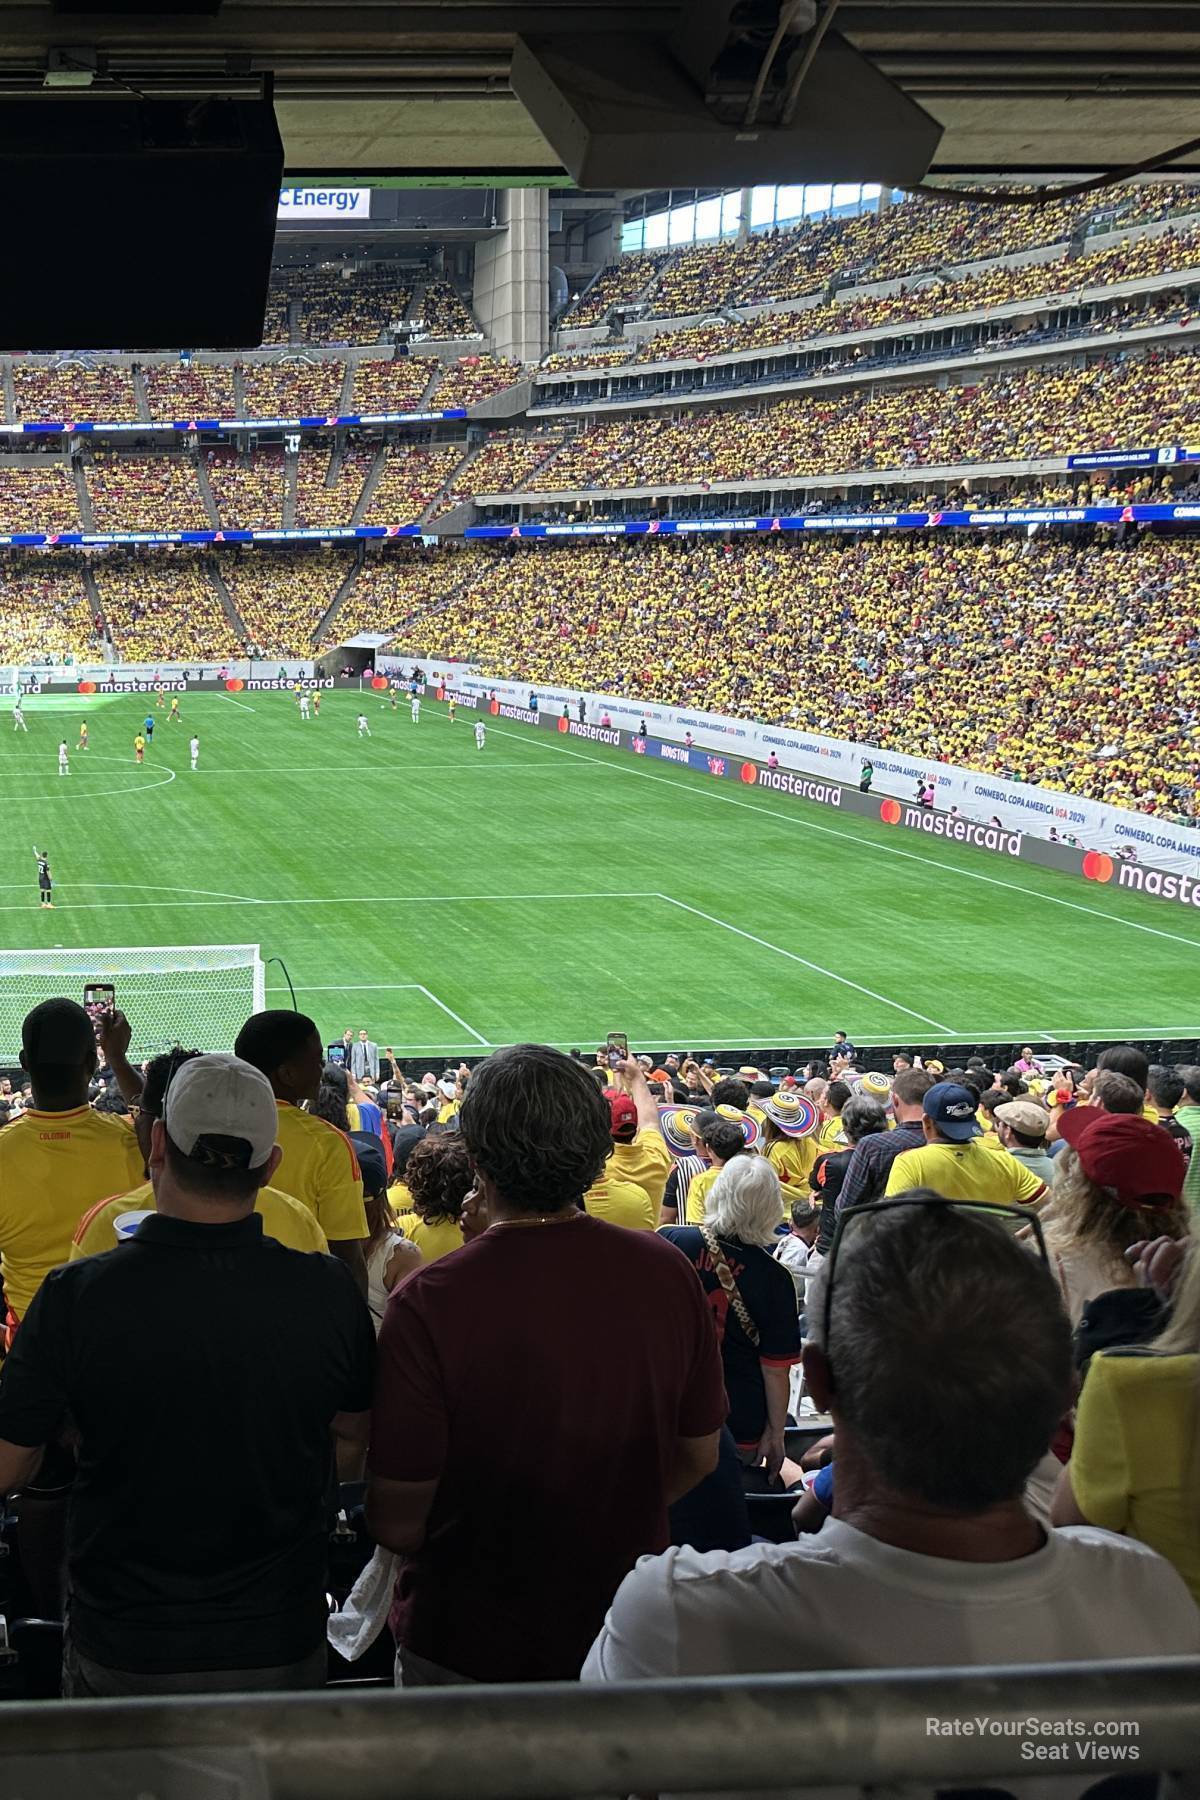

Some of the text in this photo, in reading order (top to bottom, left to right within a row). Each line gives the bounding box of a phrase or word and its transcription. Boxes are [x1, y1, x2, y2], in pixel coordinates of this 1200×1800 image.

[293, 188, 360, 210] Energy
[1164, 448, 1172, 460] 2
[100, 680, 187, 693] mastercard
[247, 676, 334, 690] mastecard
[499, 705, 539, 725] mastercard
[569, 721, 621, 746] mastercard
[661, 745, 689, 764] HOUSTON
[762, 735, 786, 747] CONMEBOL
[786, 739, 800, 749] COPA
[799, 742, 820, 754] AMERICA
[820, 748, 829, 756] USA
[888, 764, 902, 774] COPA
[902, 767, 927, 780] AMERICA
[927, 773, 938, 783] USA
[938, 776, 952, 787] 2024
[759, 769, 842, 807] mastercard
[974, 785, 1086, 824] CONMEBOL COPA AMERICA USA 2024
[904, 808, 1022, 857] mastercard
[1114, 824, 1155, 845] CONMEBOL
[1156, 835, 1176, 851] COPA
[39, 1131, 71, 1140] COLOMBIA
